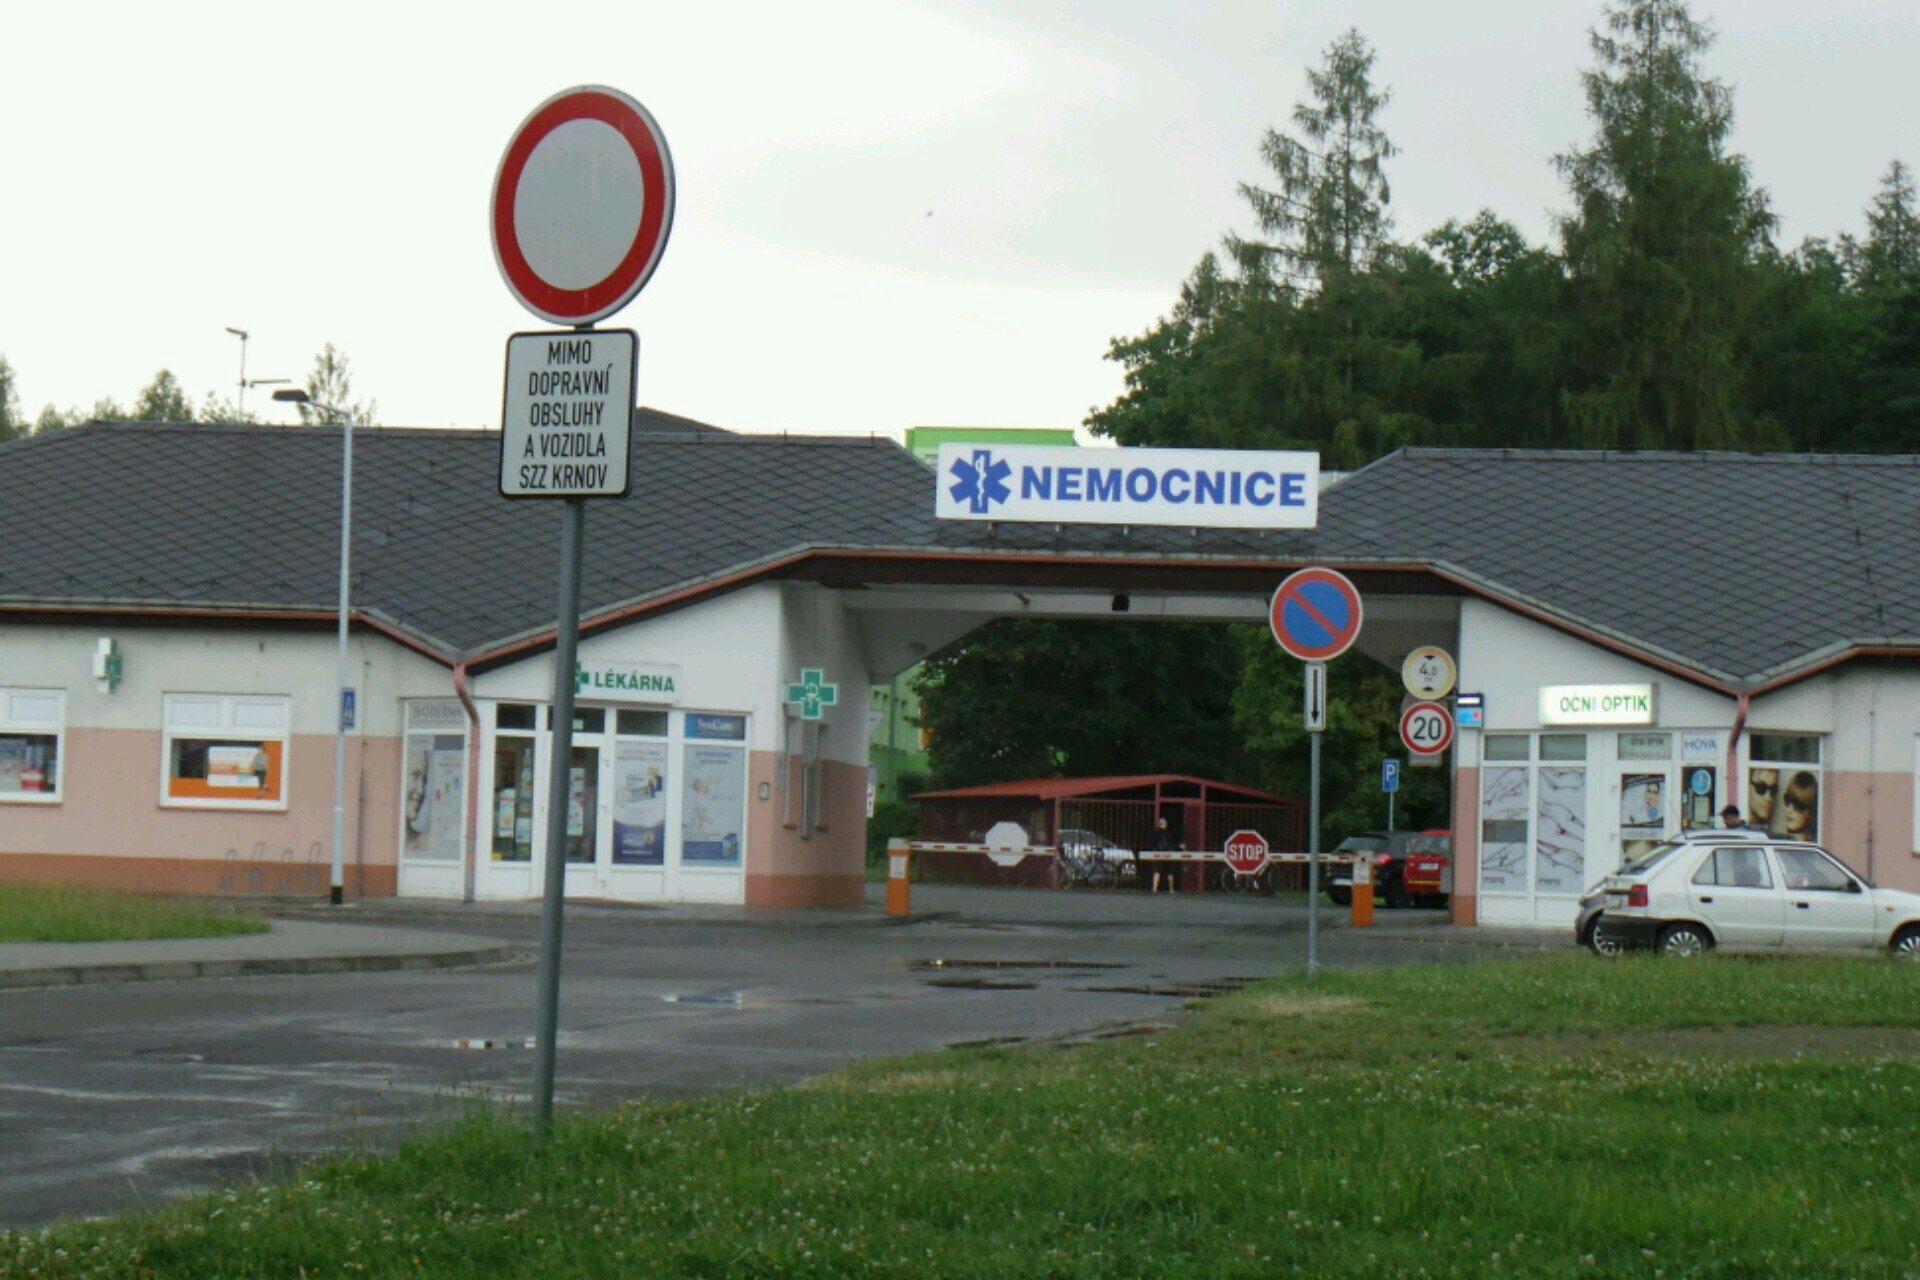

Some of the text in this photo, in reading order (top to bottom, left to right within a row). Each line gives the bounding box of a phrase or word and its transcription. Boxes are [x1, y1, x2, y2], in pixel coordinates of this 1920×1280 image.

[547, 340, 592, 365] MIMO
[528, 363, 613, 396] DOPRAVNÍ
[530, 402, 604, 427] OBSLUHY
[523, 432, 607, 458] A VOZIDLA
[519, 464, 608, 489] SZZ KRNOV
[1021, 465, 1306, 507] NEMOCNICE
[594, 668, 675, 692] LÉKÁRNA
[1601, 695, 1648, 712] OPTIK
[1413, 716, 1442, 740] 20
[1684, 738, 1718, 751] HOYA
[1386, 763, 1396, 782] P
[1229, 843, 1263, 860] STOP
